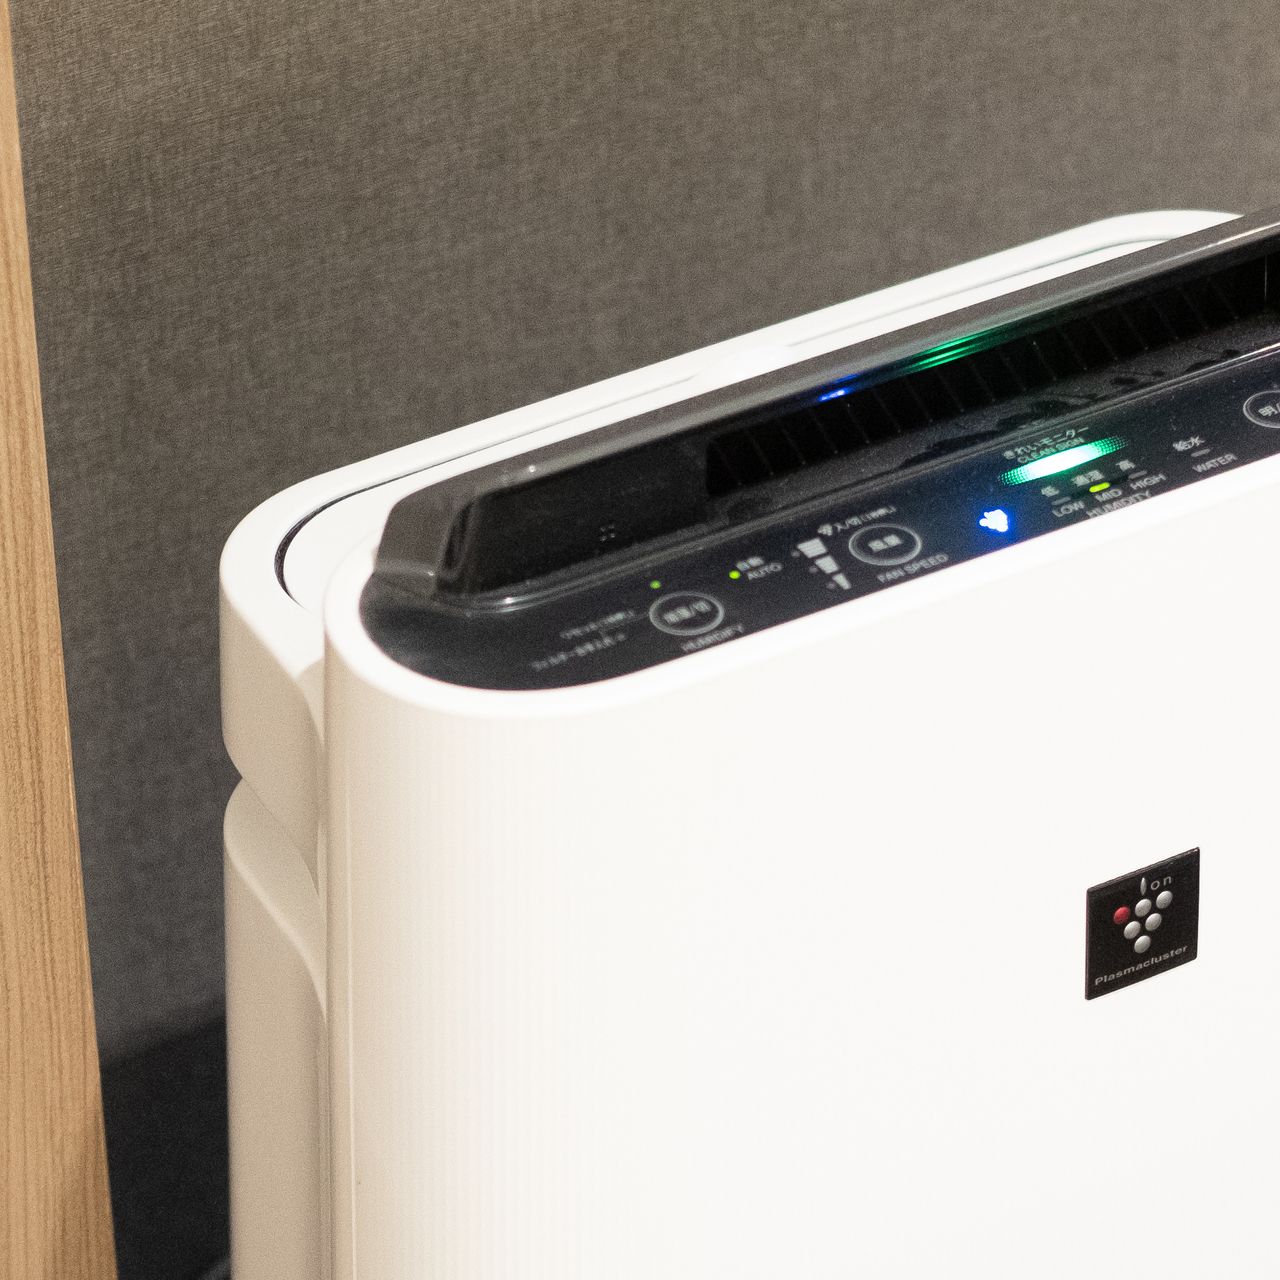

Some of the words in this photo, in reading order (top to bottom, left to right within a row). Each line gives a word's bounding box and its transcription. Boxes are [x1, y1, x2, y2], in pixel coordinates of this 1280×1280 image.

[1018, 447, 1057, 463] CLEAN
[1055, 437, 1085, 451] SIGN
[1192, 454, 1238, 473] WATER
[1052, 501, 1086, 518] LOW
[1095, 488, 1123, 502] MID
[1130, 473, 1167, 490] HIGH
[1086, 490, 1152, 518] HUMIDITY
[747, 562, 783, 580] AUTO
[877, 568, 906, 583] FAN
[904, 553, 949, 575] SPEED
[1094, 945, 1188, 986] Plasmacluster
